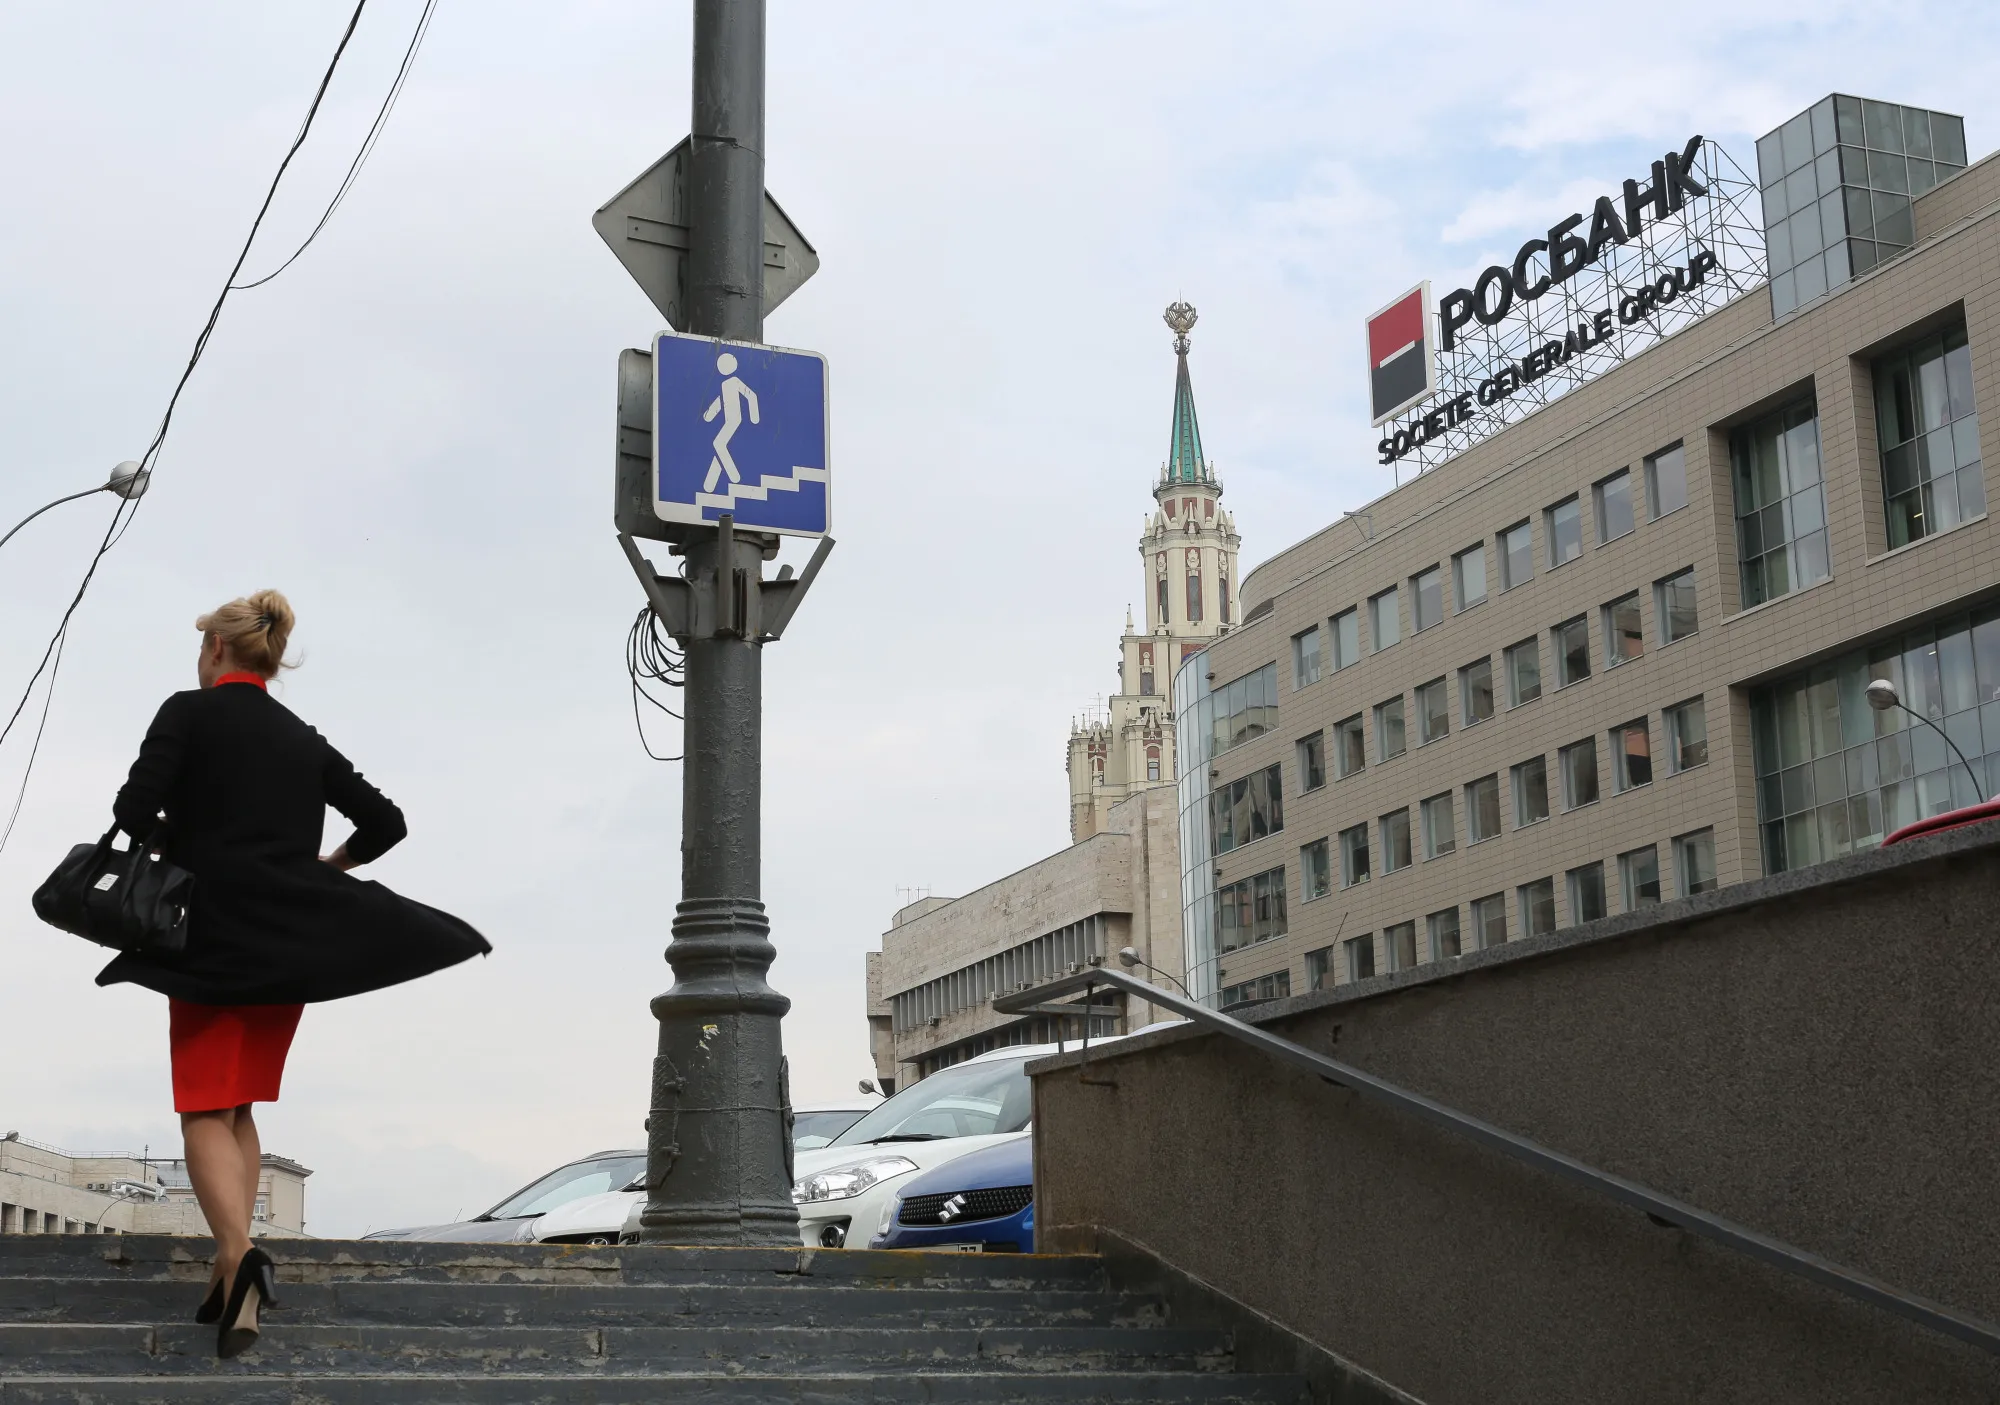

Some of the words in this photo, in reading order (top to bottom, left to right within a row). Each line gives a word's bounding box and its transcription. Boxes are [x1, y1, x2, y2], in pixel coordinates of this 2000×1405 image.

[1440, 135, 1708, 351] РОСБАНК
[1378, 391, 1474, 465] SOCIETE
[1477, 309, 1614, 406] GENERALE
[1618, 251, 1716, 325] GROUP
